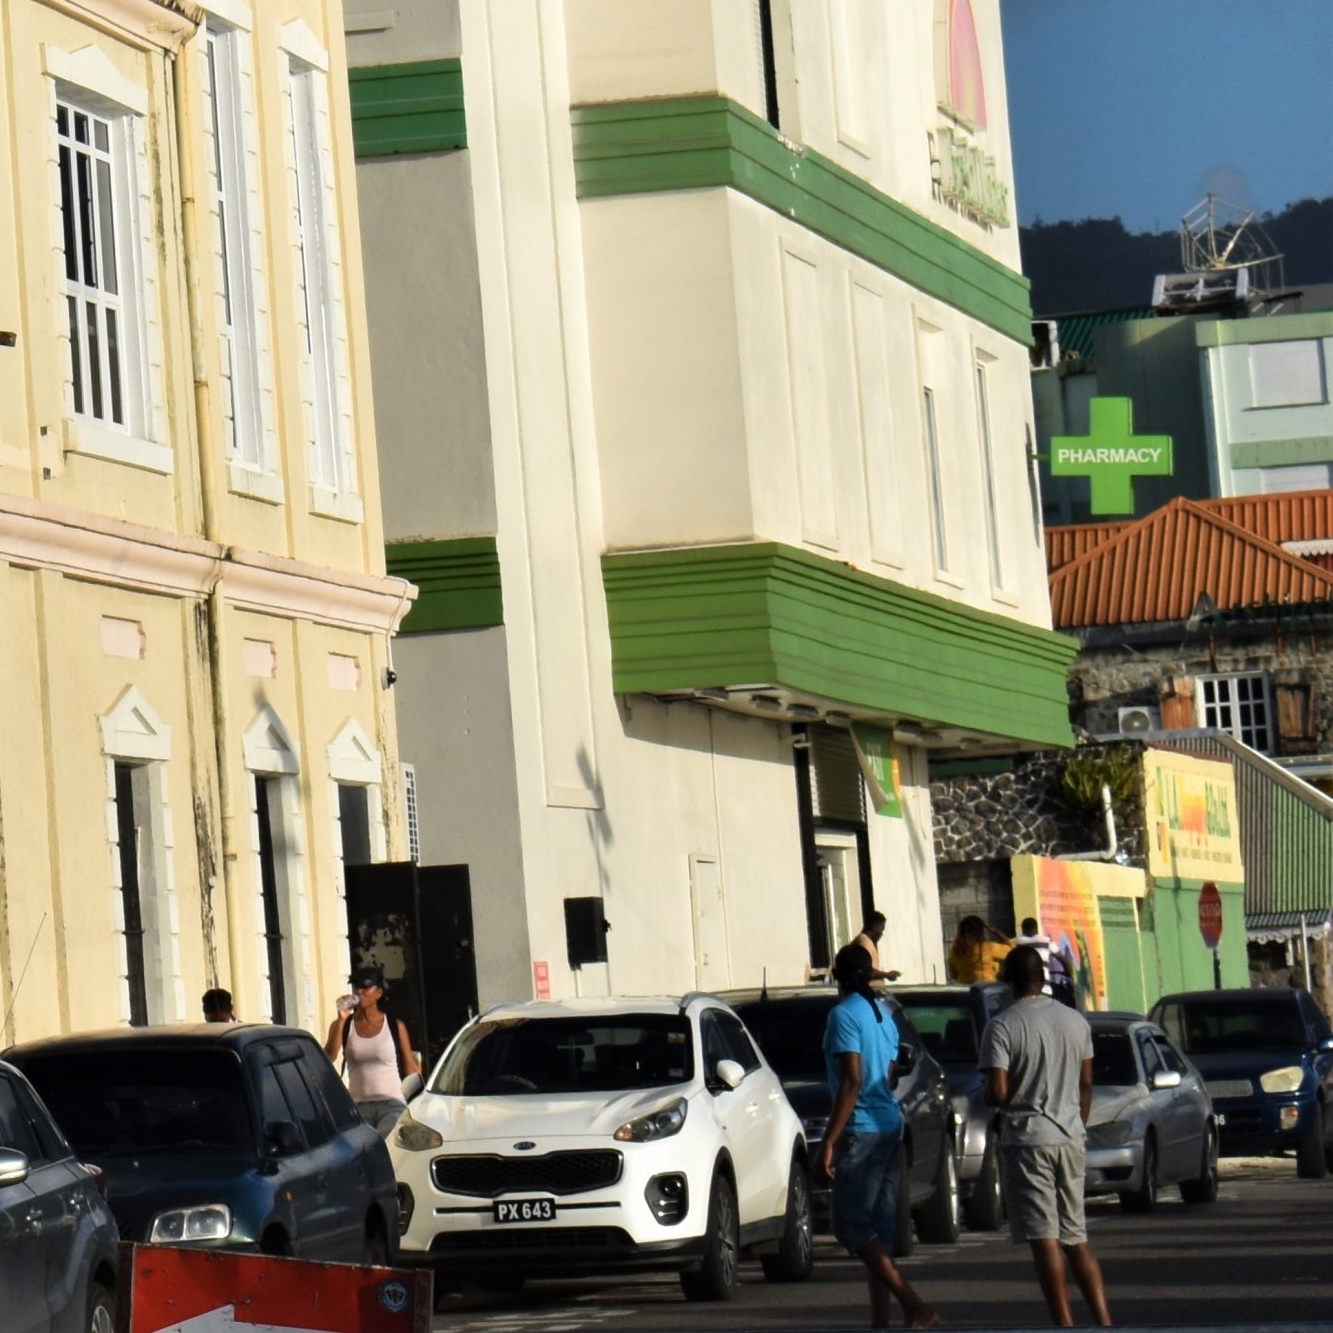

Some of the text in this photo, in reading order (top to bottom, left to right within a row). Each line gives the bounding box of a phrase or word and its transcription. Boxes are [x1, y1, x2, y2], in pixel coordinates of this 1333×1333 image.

[1058, 448, 1162, 464] PHARMACY
[498, 1201, 551, 1220] PX 643
